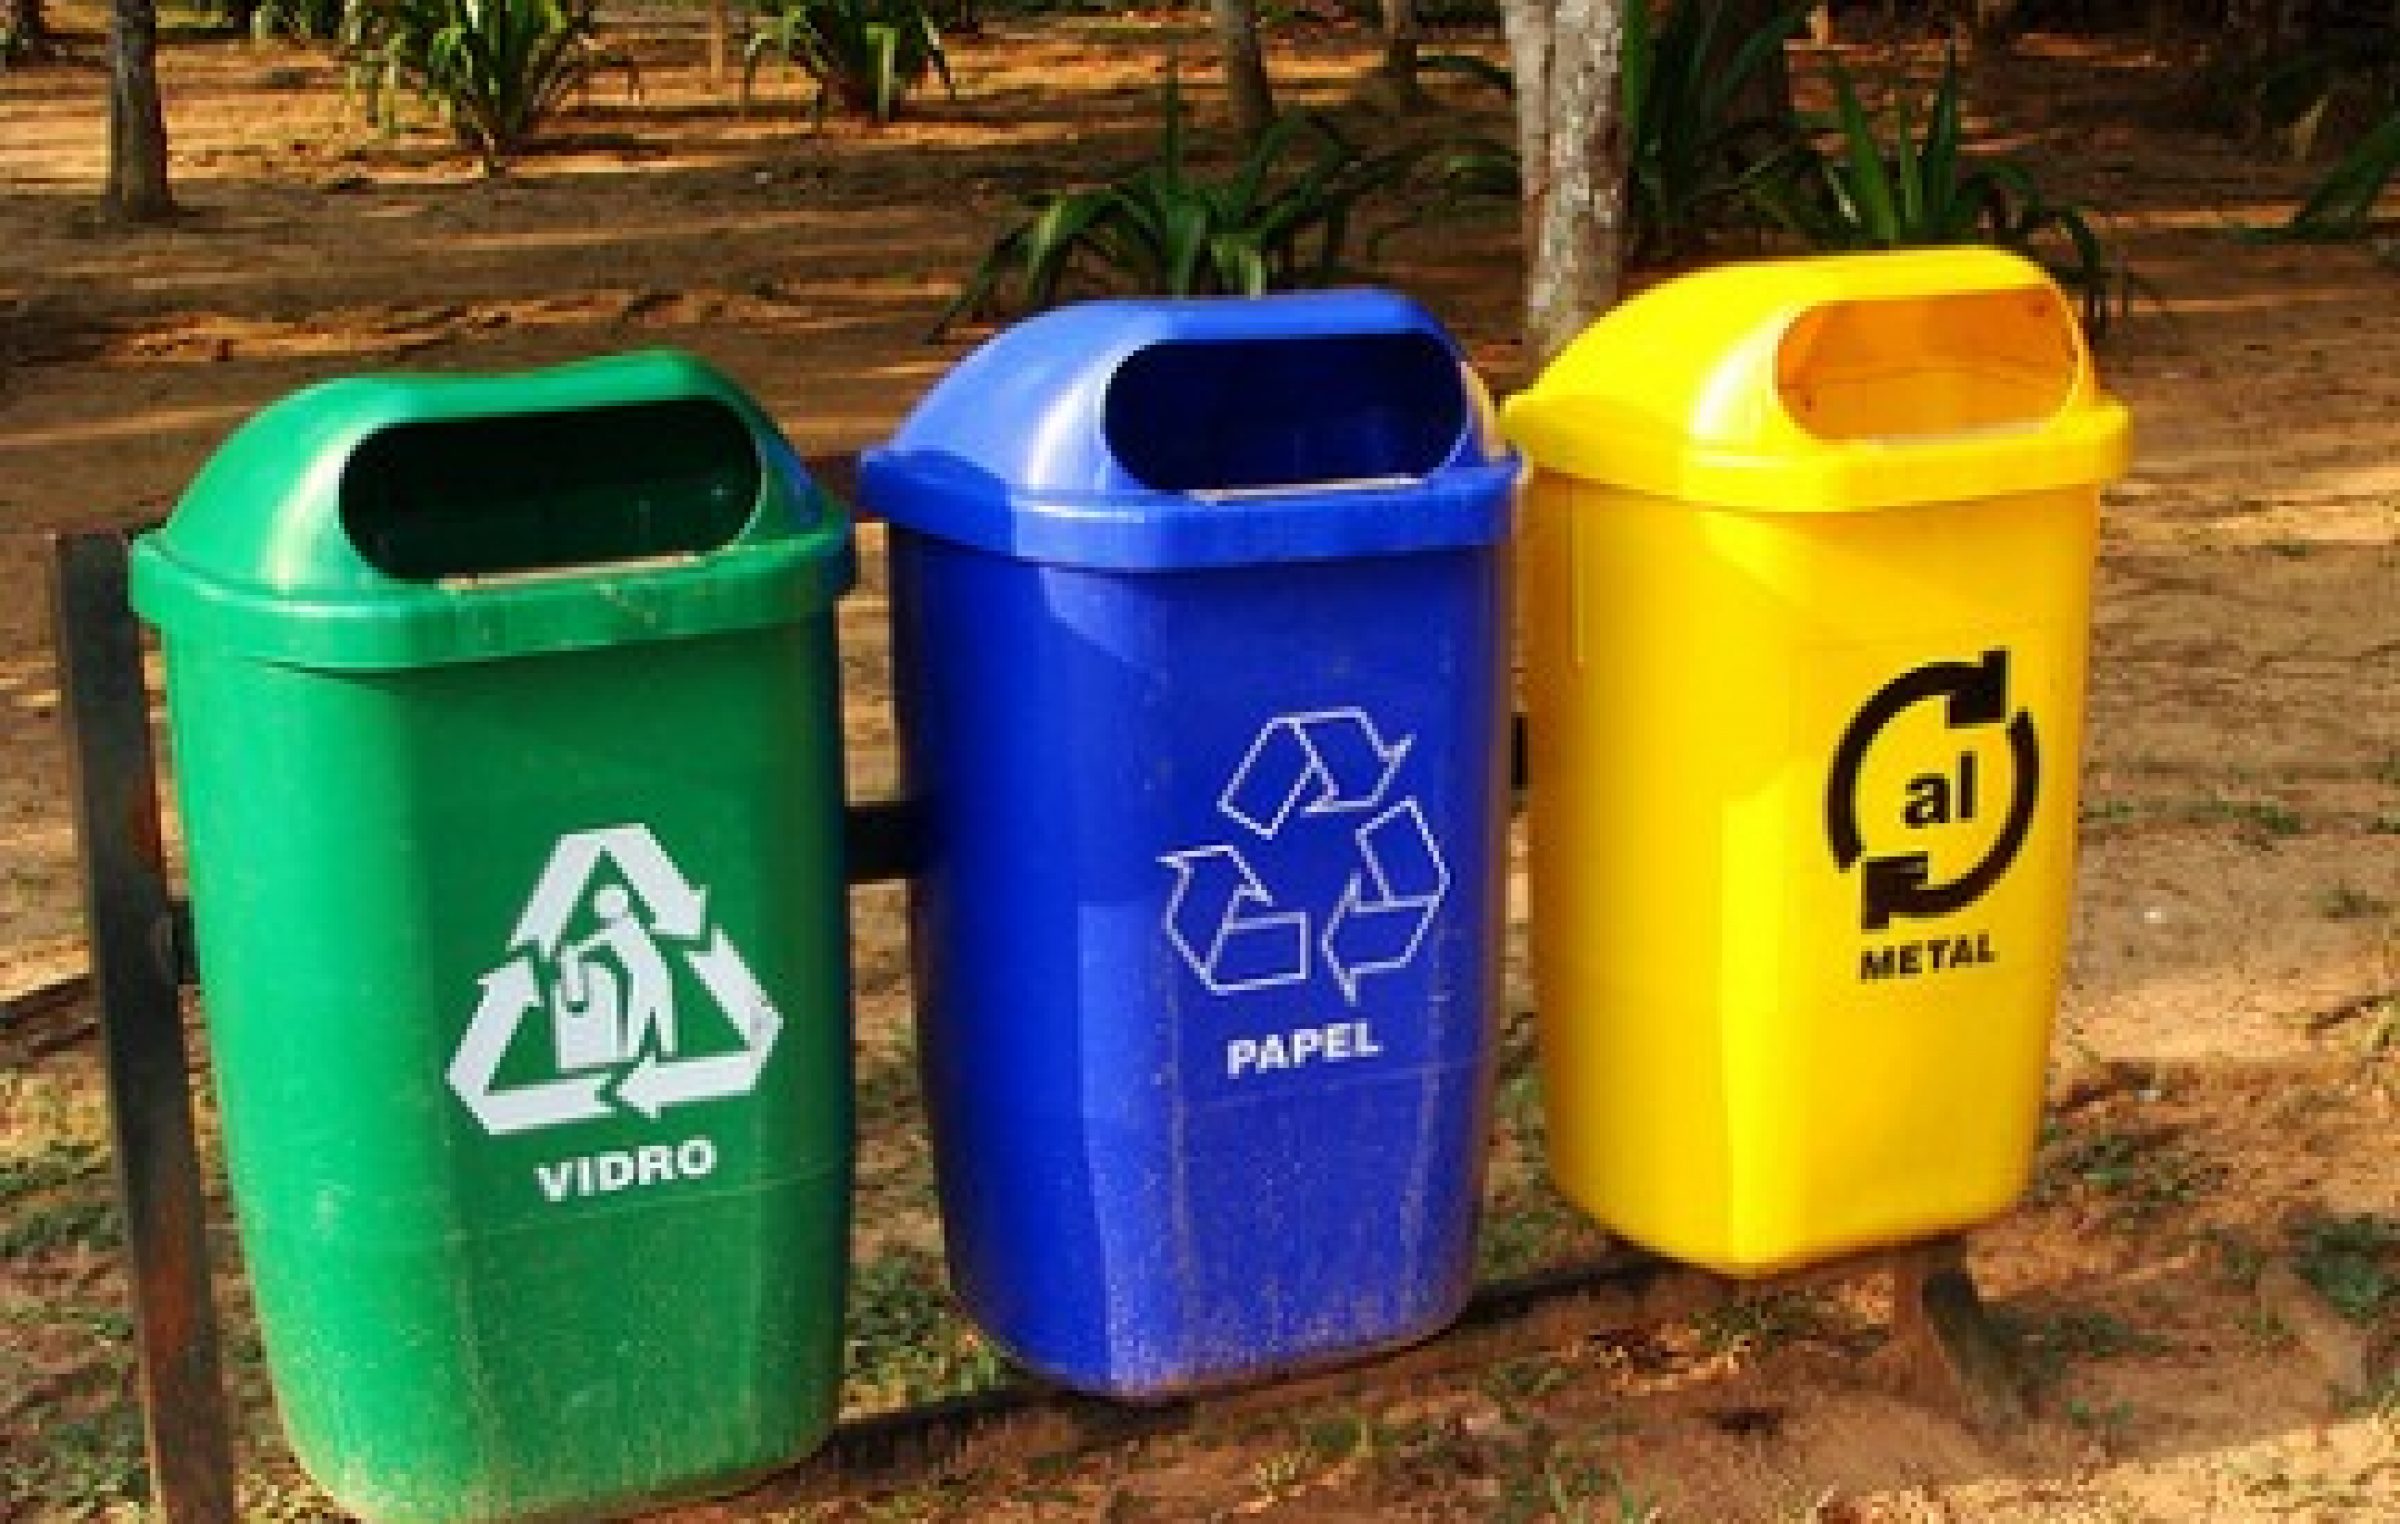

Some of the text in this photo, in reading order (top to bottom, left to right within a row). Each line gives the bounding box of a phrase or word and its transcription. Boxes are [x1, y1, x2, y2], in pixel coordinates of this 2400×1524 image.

[1902, 751, 1977, 829] al
[1860, 934, 1996, 981] METAL
[1226, 1019, 1379, 1079] PAPEL
[536, 1137, 717, 1202] VIDRO
